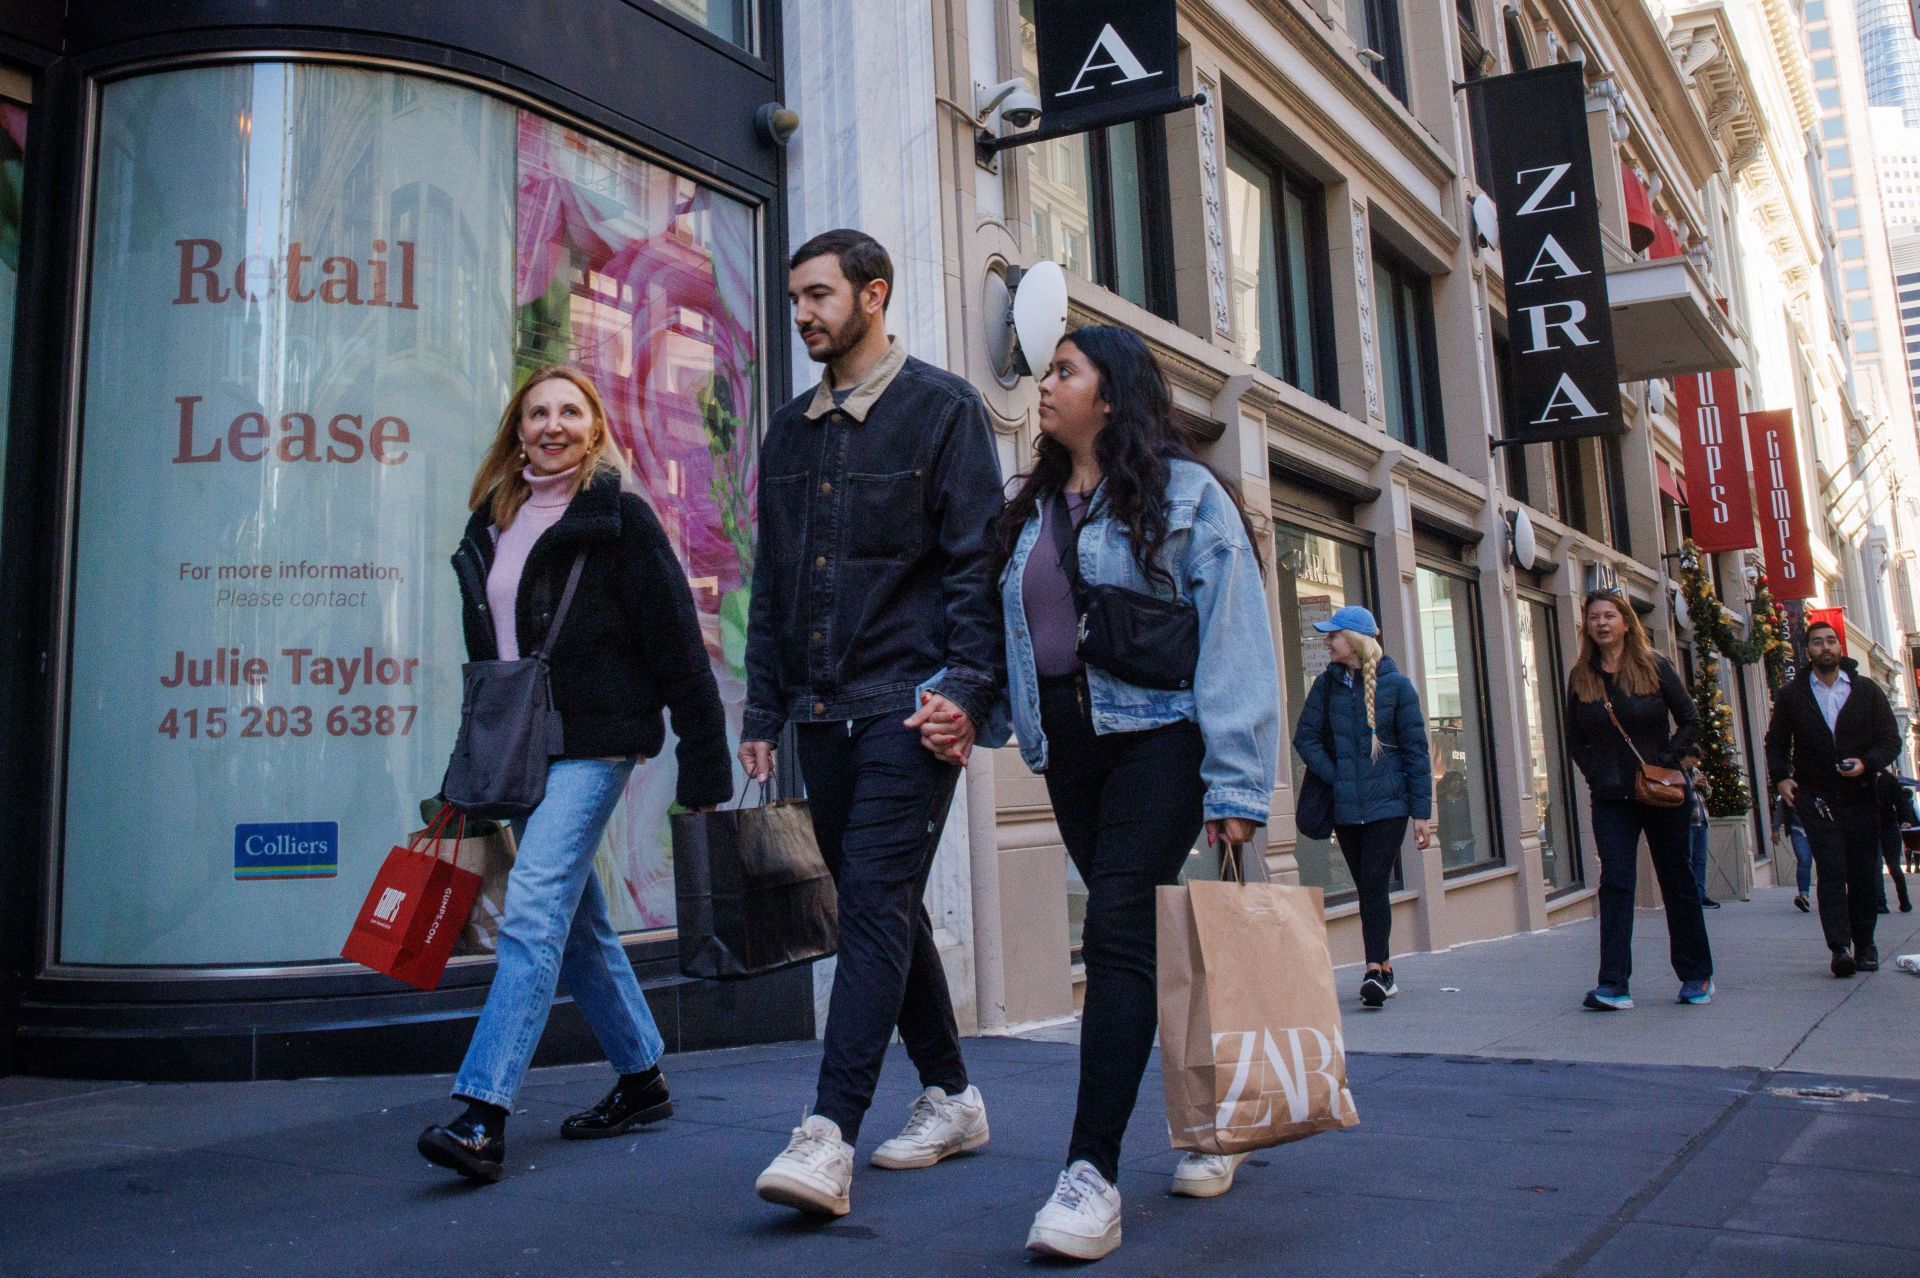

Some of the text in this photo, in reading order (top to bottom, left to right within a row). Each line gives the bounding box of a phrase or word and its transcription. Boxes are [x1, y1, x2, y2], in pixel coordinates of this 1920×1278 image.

[1055, 23, 1163, 98] A
[172, 237, 419, 310] Retail
[1515, 162, 1609, 425] ZARA
[172, 395, 411, 466] Lease
[1697, 371, 1729, 525] UMPS
[1766, 429, 1796, 580] GUMPS
[178, 560, 405, 584] For more information,
[215, 588, 368, 608] Please contact
[159, 646, 420, 696] Julie Taylor
[158, 704, 419, 740] 415 203 6387
[244, 834, 329, 857] Colliers
[424, 887, 453, 945] GUMPS.COM
